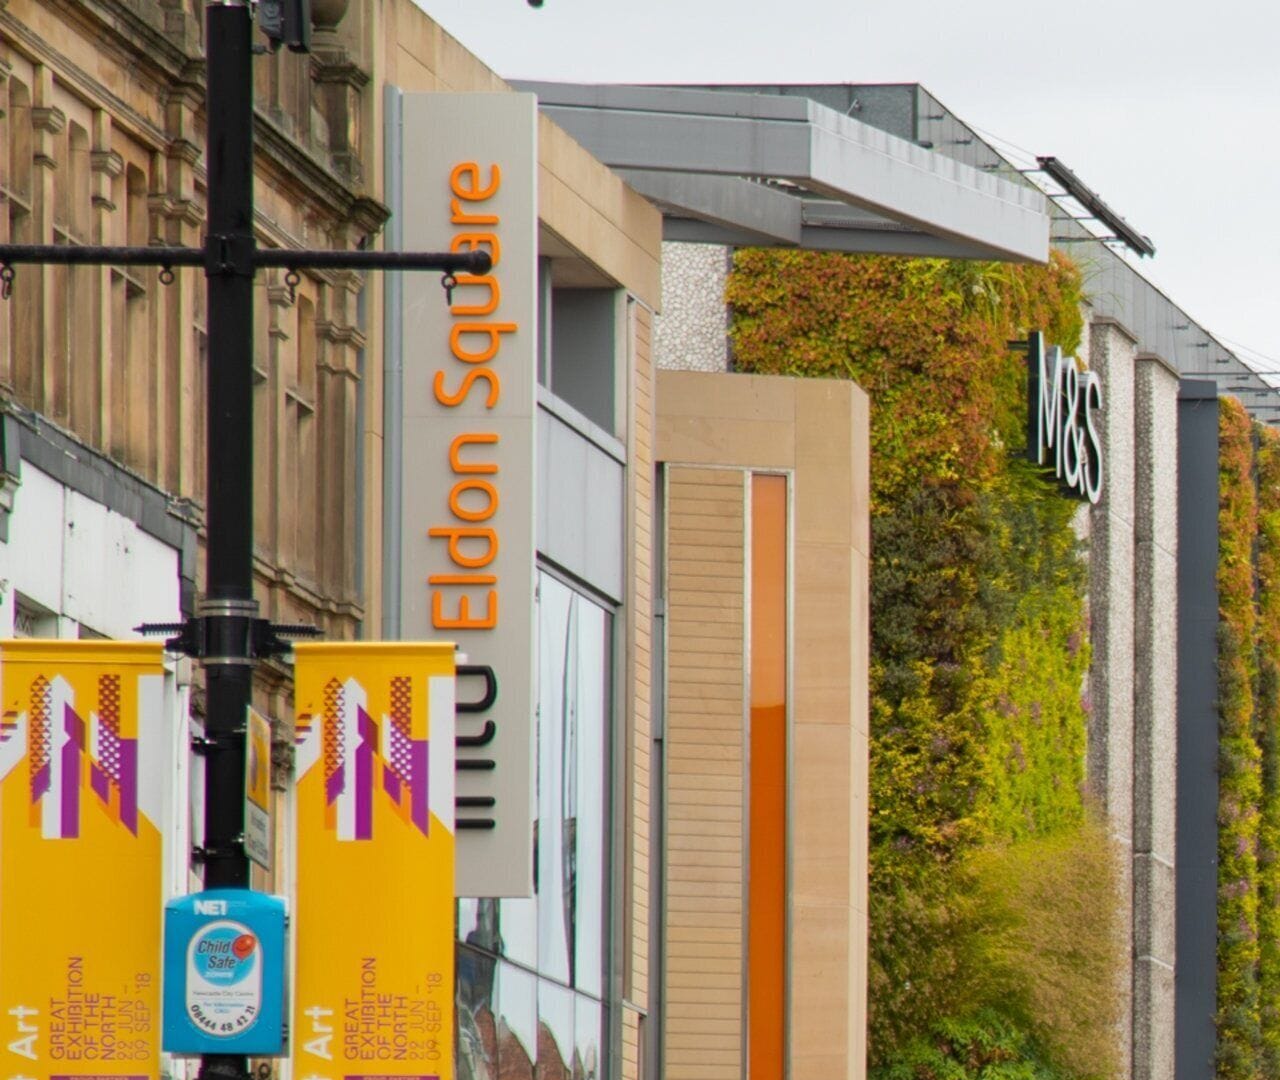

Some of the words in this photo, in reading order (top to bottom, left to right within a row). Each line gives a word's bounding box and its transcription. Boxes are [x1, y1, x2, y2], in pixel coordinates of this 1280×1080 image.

[432, 161, 518, 410] Square
[1036, 330, 1104, 505] M&S
[428, 432, 499, 631] Eldon
[198, 939, 231, 954] Child
[208, 955, 236, 969] Safe
[8, 1004, 39, 1060] Art
[50, 997, 65, 1060] GREAT
[66, 956, 83, 1061] EXHIBITION
[84, 992, 100, 1023] THE
[101, 995, 116, 1061] NORTH
[303, 1005, 334, 1061] Art
[344, 998, 359, 1061] GREAT
[360, 957, 376, 1060] EXHIBITION
[376, 992, 393, 1024] THE
[393, 995, 408, 1061] NORTH
[84, 1026, 100, 1060] OF
[376, 1027, 392, 1061] OF
